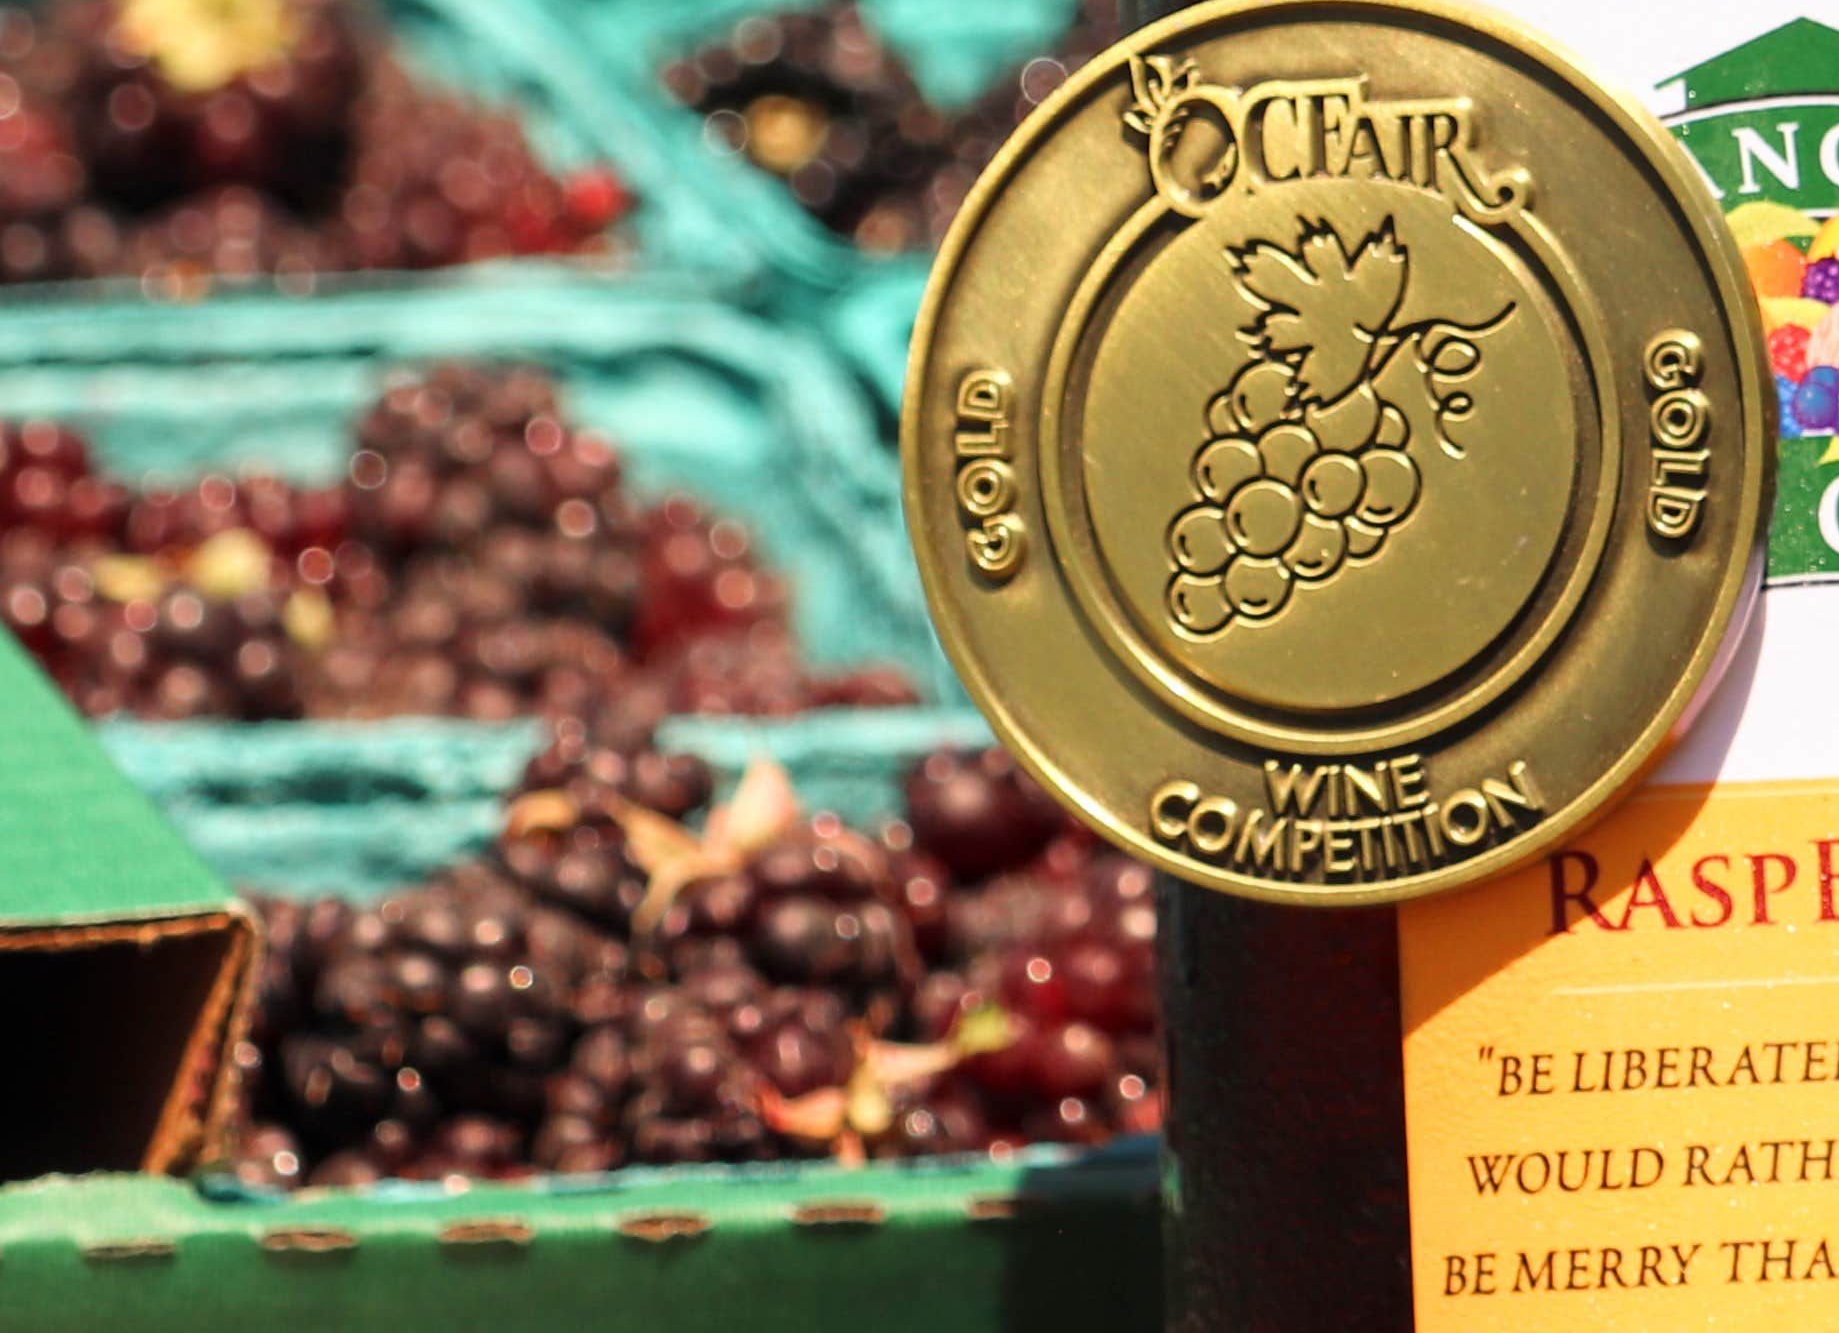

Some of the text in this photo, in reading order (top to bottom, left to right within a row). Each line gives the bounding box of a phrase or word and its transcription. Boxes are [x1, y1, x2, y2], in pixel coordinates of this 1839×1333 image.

[955, 369, 1022, 581] GOLD
[1643, 331, 1710, 540] GOLD
[1149, 763, 1545, 873] COMPETITION
[1264, 758, 1431, 816] WINE
[1467, 1148, 1664, 1196] WOULD
[1444, 1253, 1497, 1298] BE
[1512, 1244, 1701, 1293] MERRY
